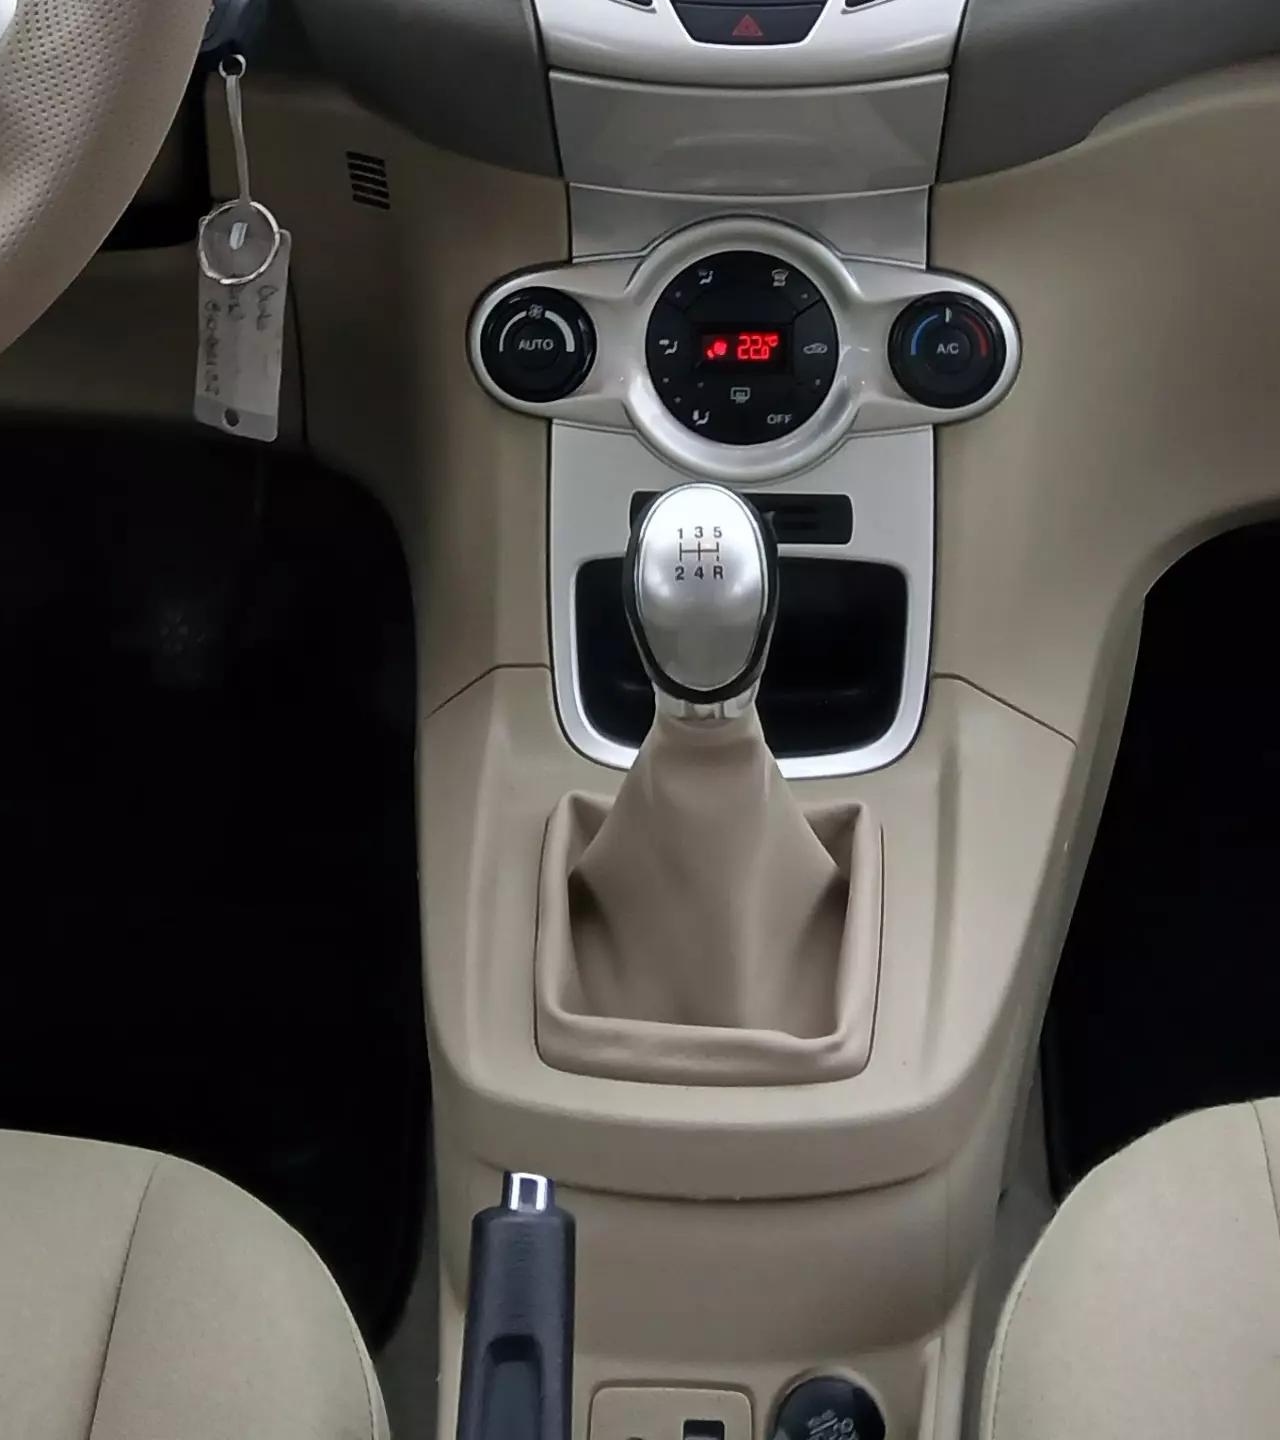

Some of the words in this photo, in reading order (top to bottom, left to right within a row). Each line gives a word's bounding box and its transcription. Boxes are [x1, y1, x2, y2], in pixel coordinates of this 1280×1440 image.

[518, 339, 554, 351] AUTO
[936, 343, 959, 354] A/C
[767, 414, 792, 424] OFF
[694, 526, 703, 538] 3
[713, 526, 722, 538] 5
[675, 566, 685, 581] 2
[694, 566, 704, 580] 4
[713, 566, 723, 580] R
